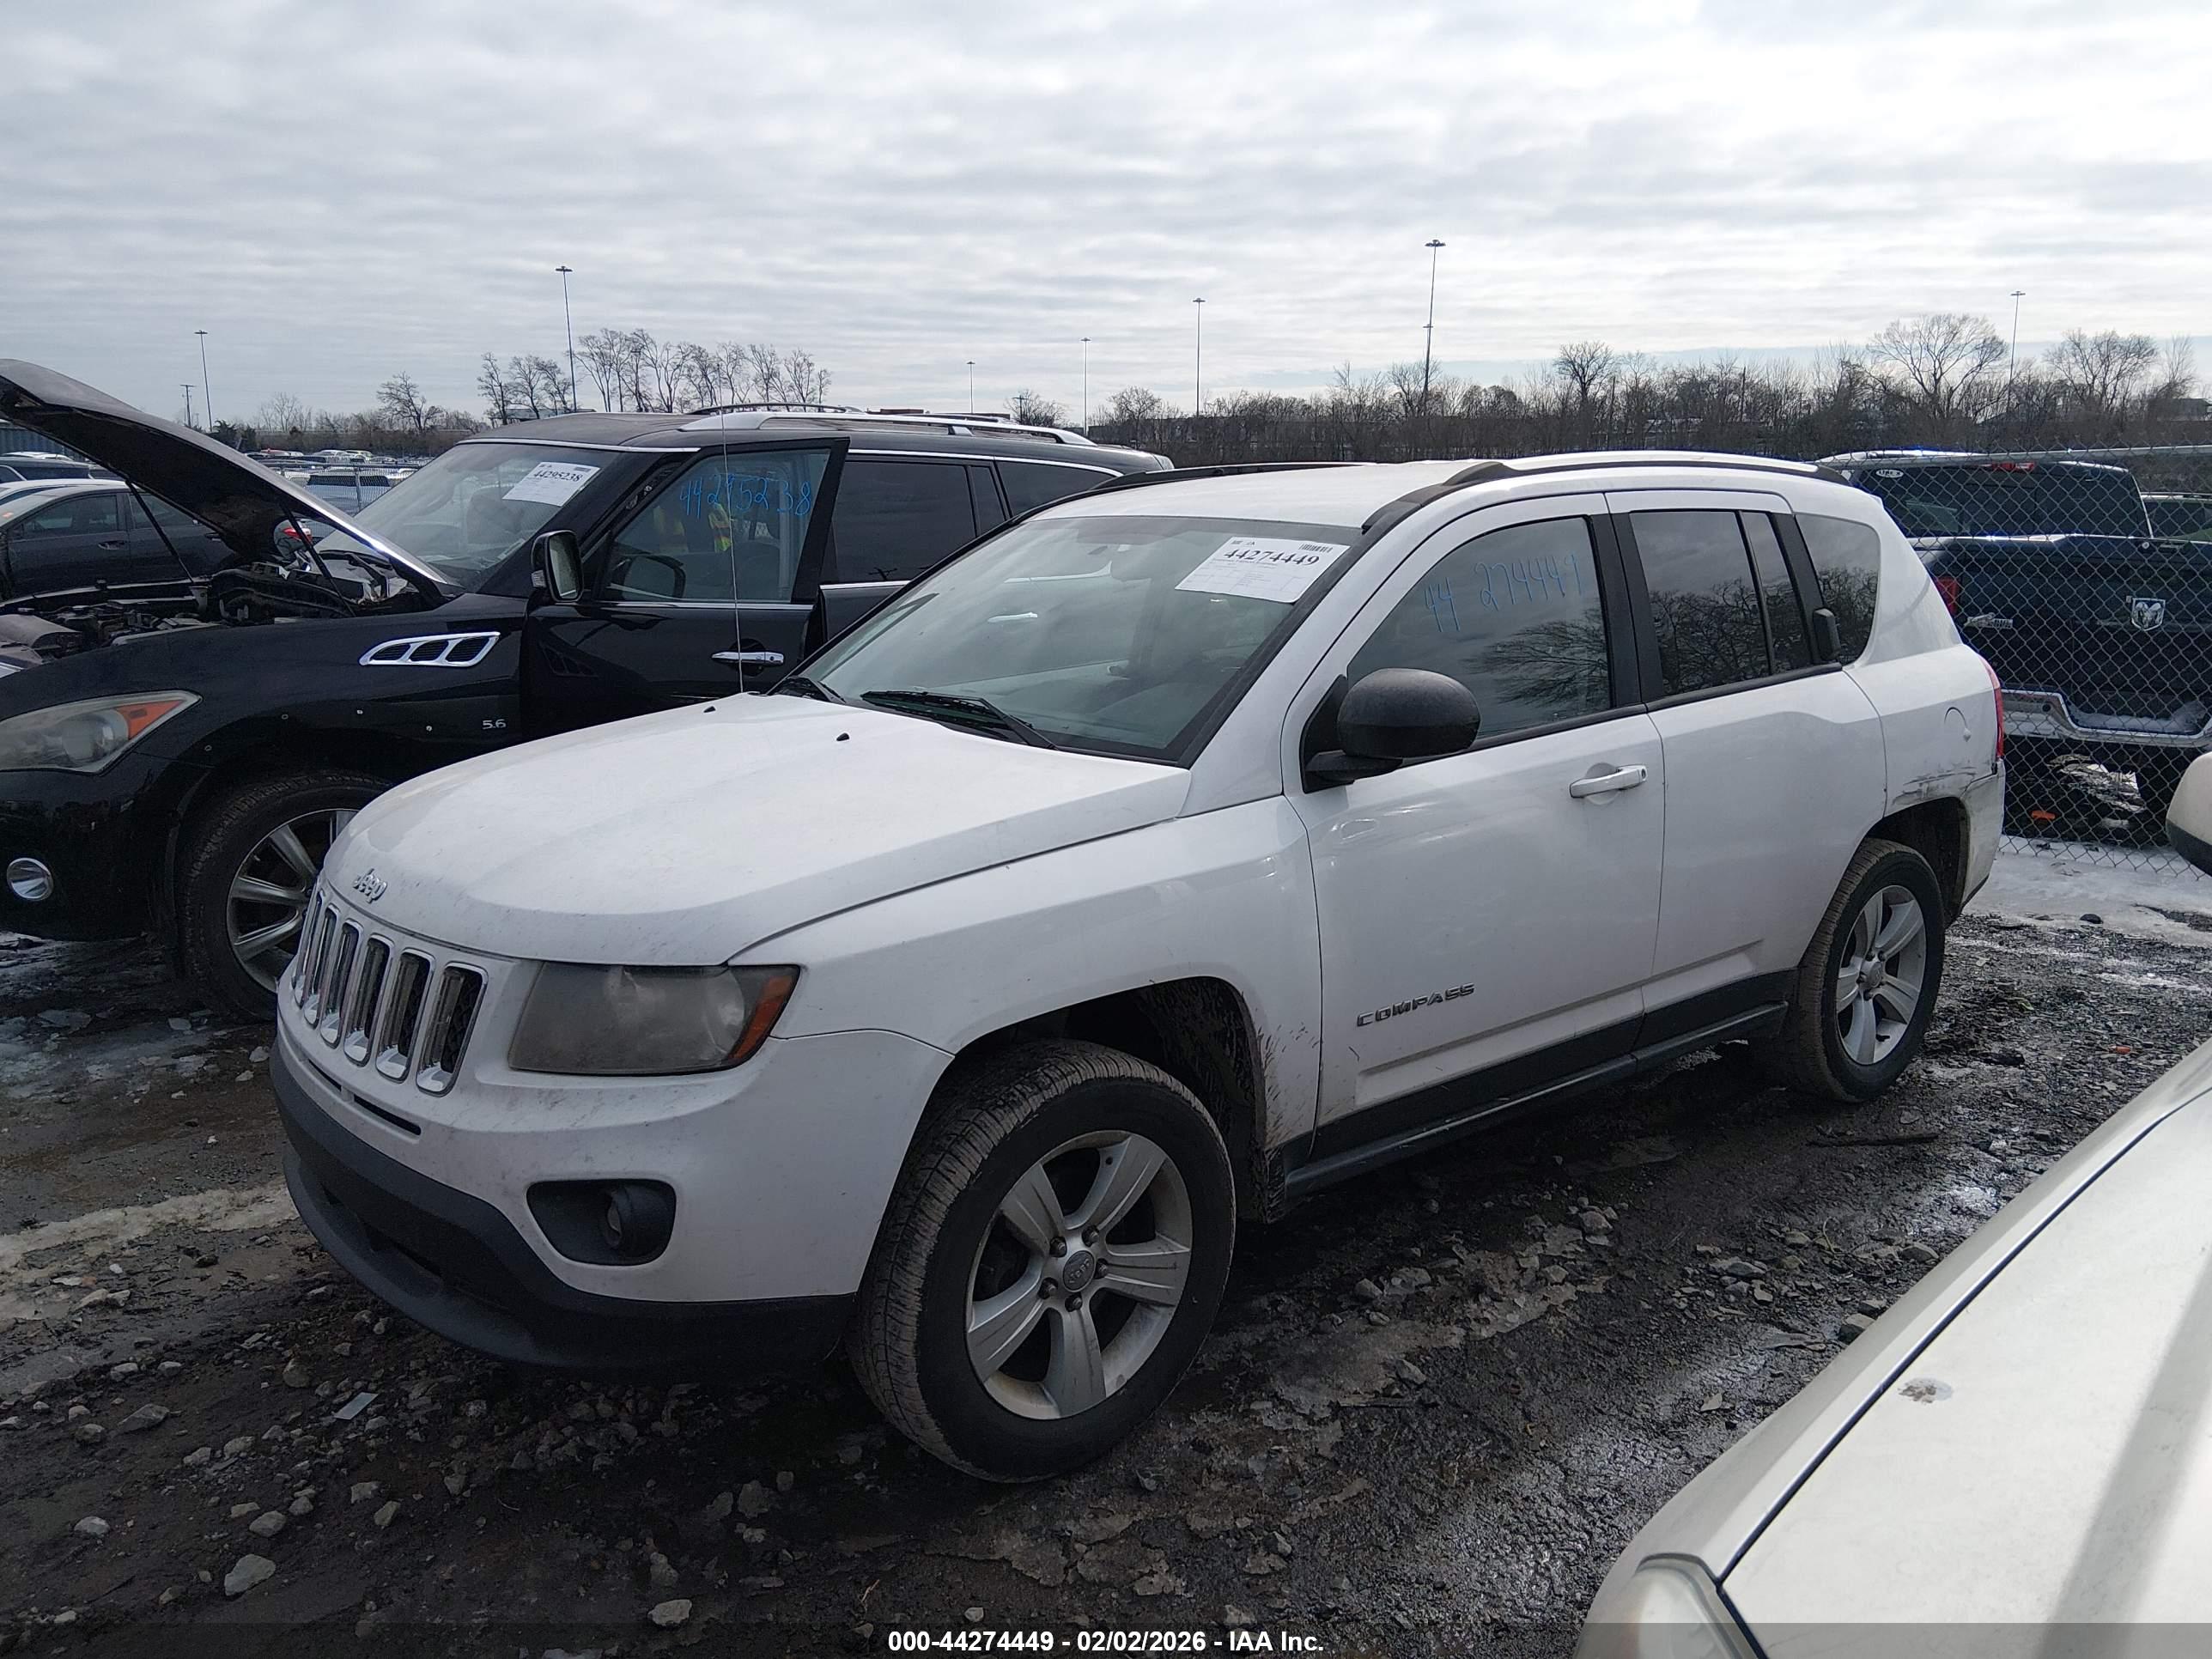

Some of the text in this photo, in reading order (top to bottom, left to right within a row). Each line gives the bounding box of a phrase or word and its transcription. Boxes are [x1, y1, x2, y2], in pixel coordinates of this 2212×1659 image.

[533, 470, 583, 483] 44295238
[1224, 549, 1320, 566] 44274449
[352, 868, 387, 904] Jeep
[1357, 982, 1475, 1027] COMPASS
